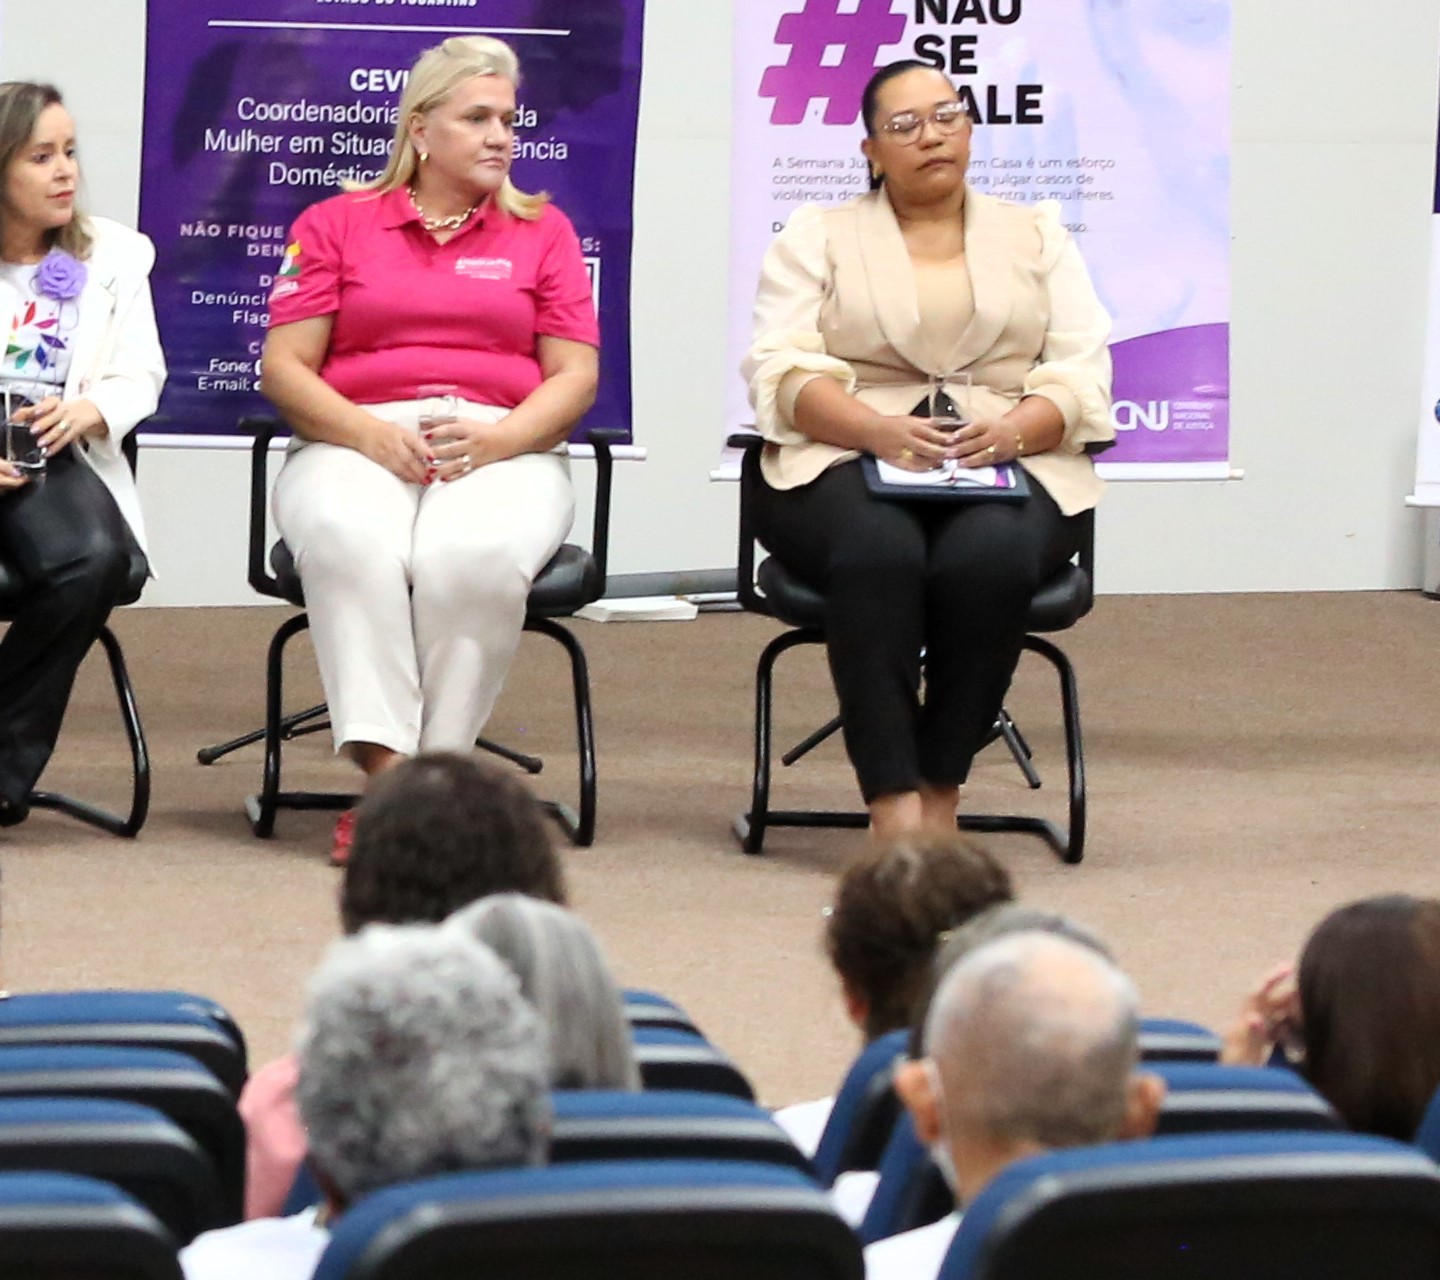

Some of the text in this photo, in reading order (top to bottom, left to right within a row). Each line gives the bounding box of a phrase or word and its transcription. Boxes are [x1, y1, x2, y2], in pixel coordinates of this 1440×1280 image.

[913, 33, 979, 75] SE
[349, 68, 410, 93] CEVI
[237, 97, 401, 125] Coordenadoria
[956, 84, 1043, 125] ALE
[203, 127, 569, 160] Mulher em Situa ência
[991, 157, 1022, 169] Casa
[1039, 159, 1062, 168] um
[1076, 173, 1095, 185] de
[180, 221, 284, 240] NÃO FIQUE
[247, 244, 286, 258] DEN
[191, 290, 272, 306] Denúnci
[232, 310, 273, 328] Flag
[209, 358, 253, 374] Fone:
[198, 377, 250, 392] E-mail:
